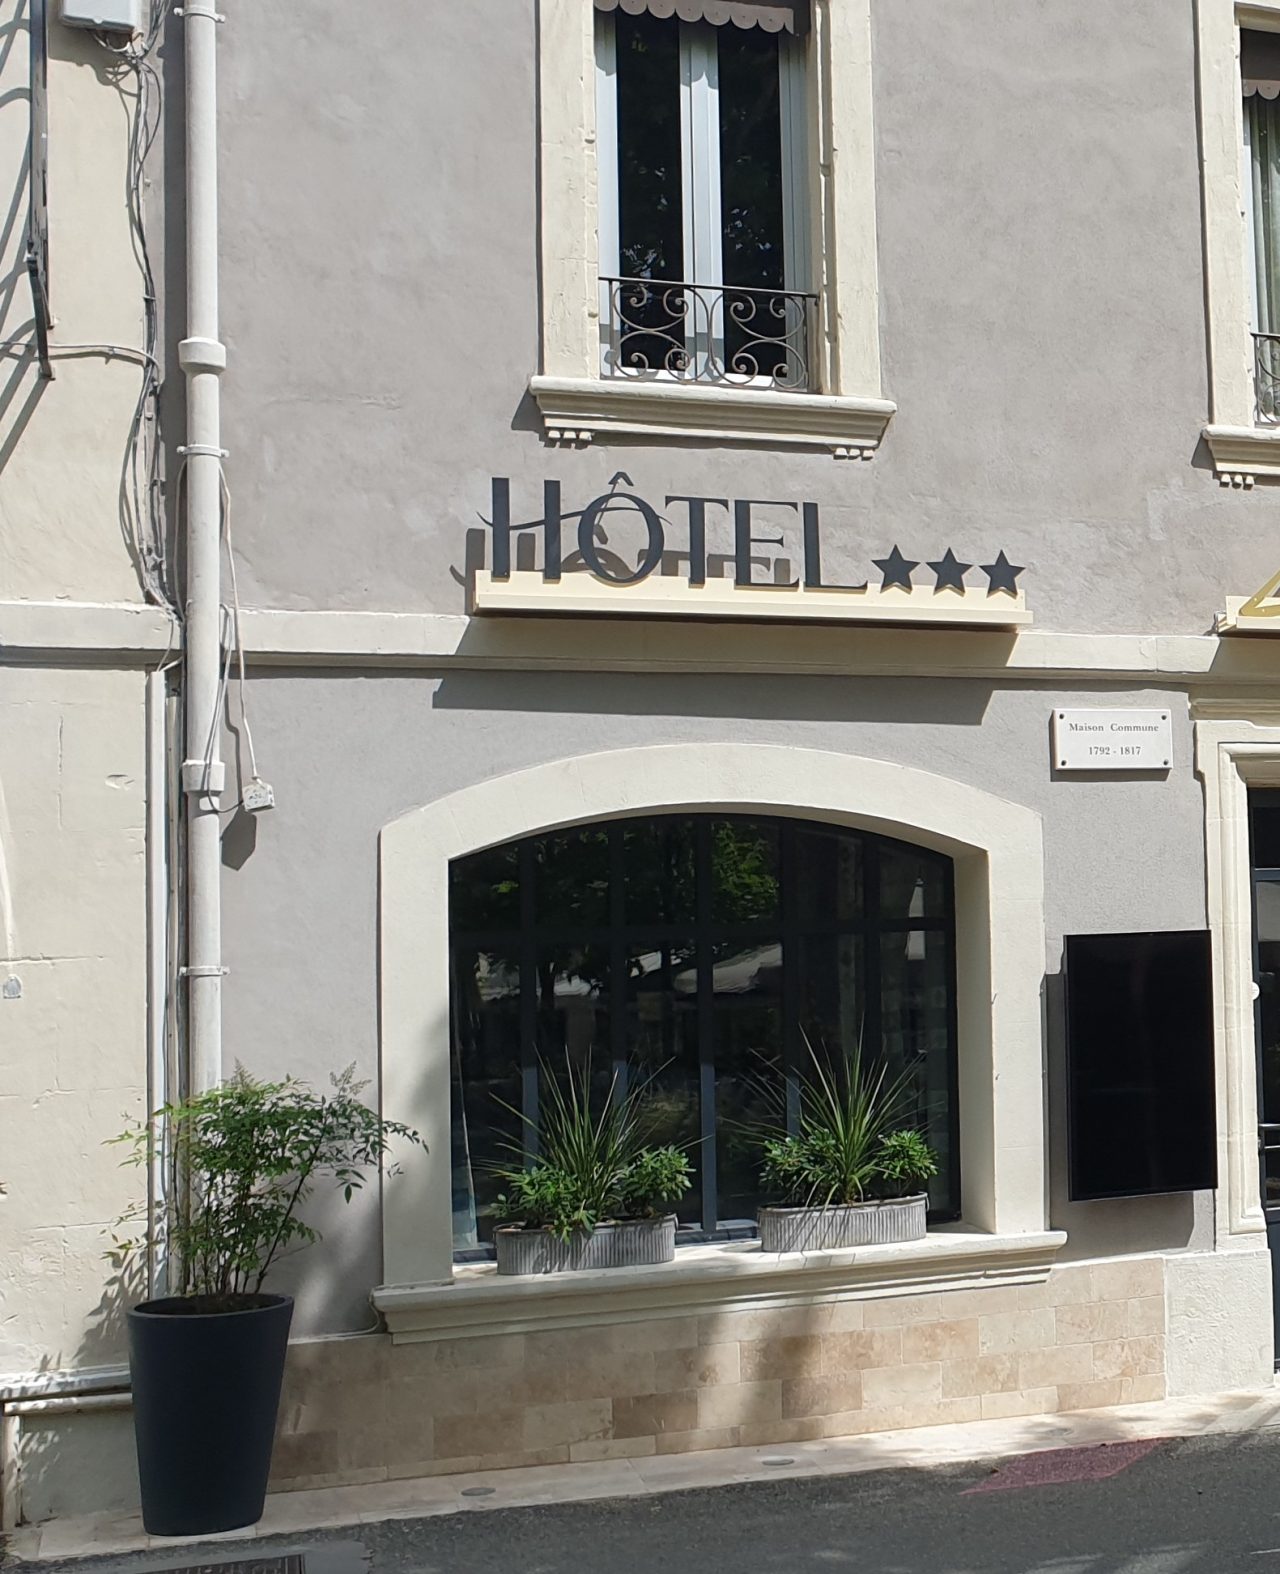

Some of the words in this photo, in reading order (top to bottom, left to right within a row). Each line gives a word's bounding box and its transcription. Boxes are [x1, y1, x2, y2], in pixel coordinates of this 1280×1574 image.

[476, 471, 869, 589] HÔTEL
[1069, 723, 1104, 732] Maison
[1110, 723, 1159, 732] Commune
[1089, 746, 1110, 755] 1792
[1120, 746, 1141, 755] 1817
